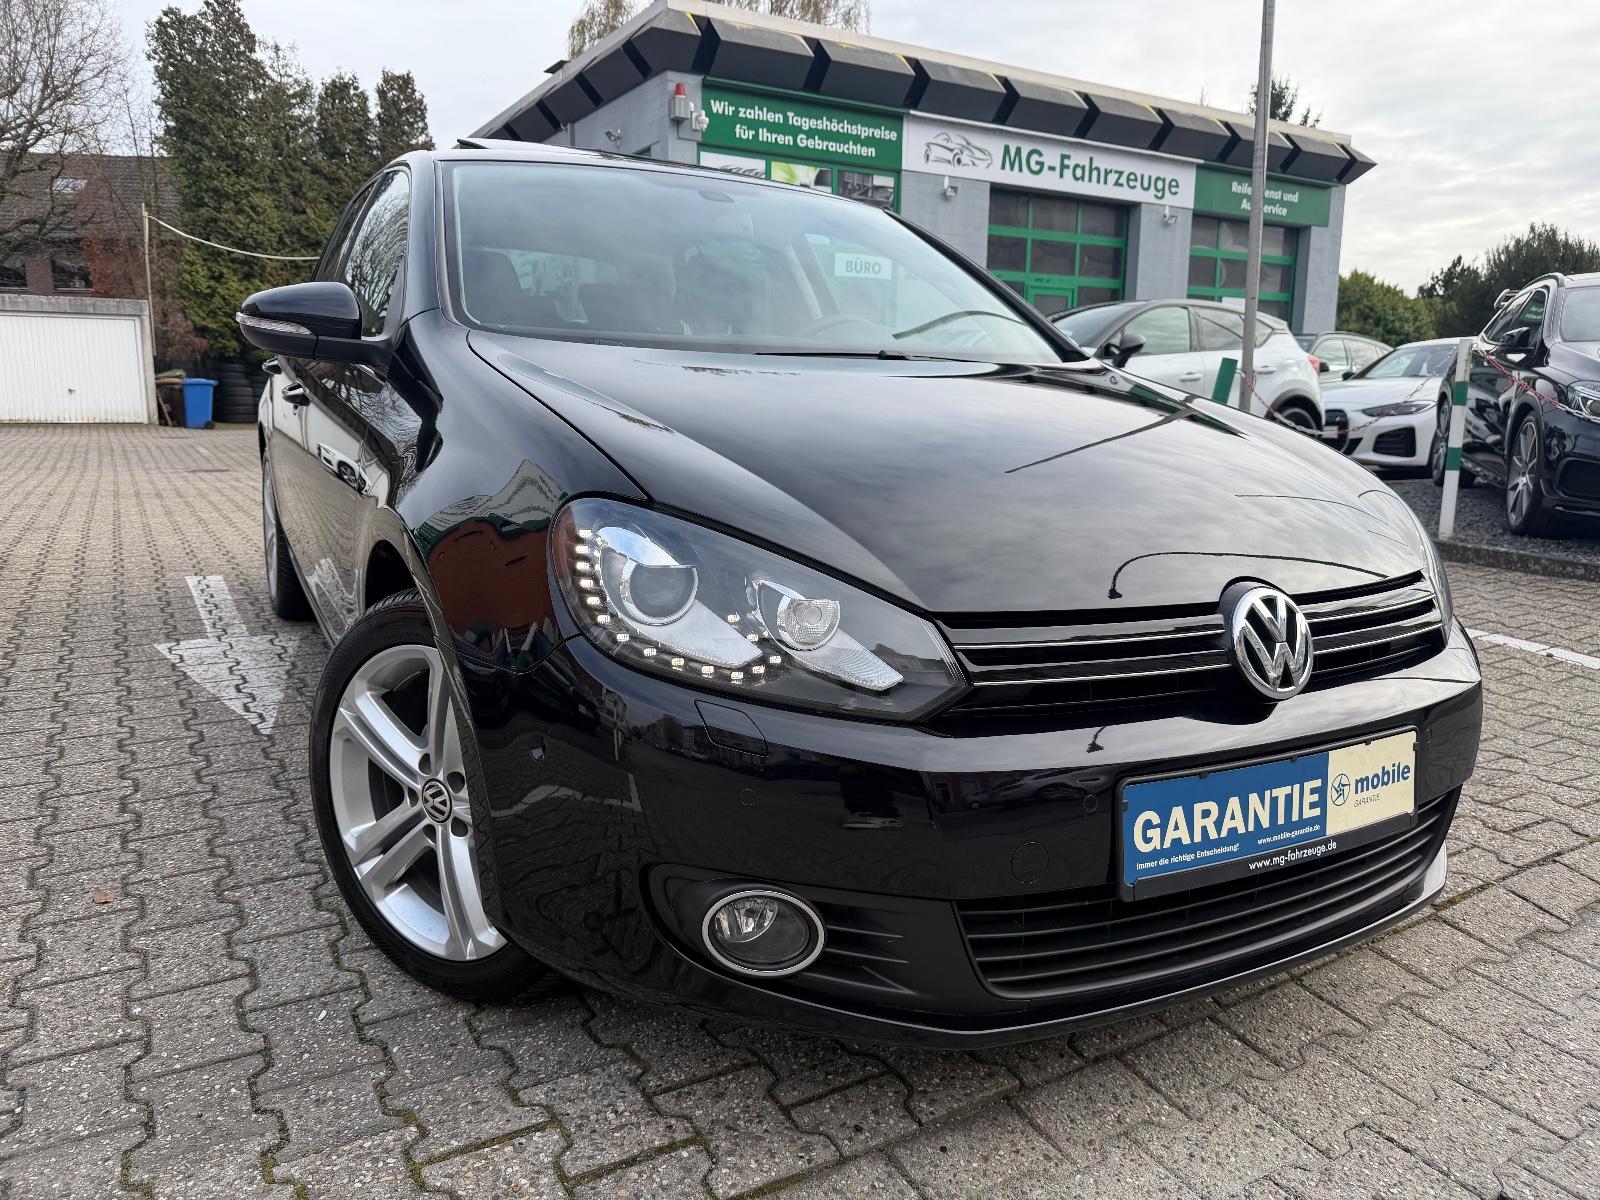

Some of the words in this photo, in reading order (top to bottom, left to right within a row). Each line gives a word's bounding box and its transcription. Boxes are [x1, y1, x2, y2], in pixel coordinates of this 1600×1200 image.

[710, 99, 735, 116] Wir
[738, 106, 784, 124] zahlen
[787, 111, 897, 141] Tageshöchstpreise
[735, 124, 755, 141] für
[759, 128, 793, 146] Ihren
[797, 134, 876, 158] Gebrauchten
[1000, 143, 1180, 200] MG-Fahrzeuge
[1231, 181, 1282, 200] Reifeenst
[1283, 191, 1299, 203] und
[1240, 198, 1288, 216] Auervice
[845, 257, 882, 275] BÜRO
[1354, 762, 1411, 795] mobile
[1133, 778, 1323, 853] GARANTIE
[1353, 794, 1380, 808] GARANTIE
[1136, 860, 1158, 870] Immer
[1158, 857, 1169, 866] die
[1170, 854, 1195, 864] richtige
[1248, 839, 1337, 870] www.mg-fahrzeuge.de
